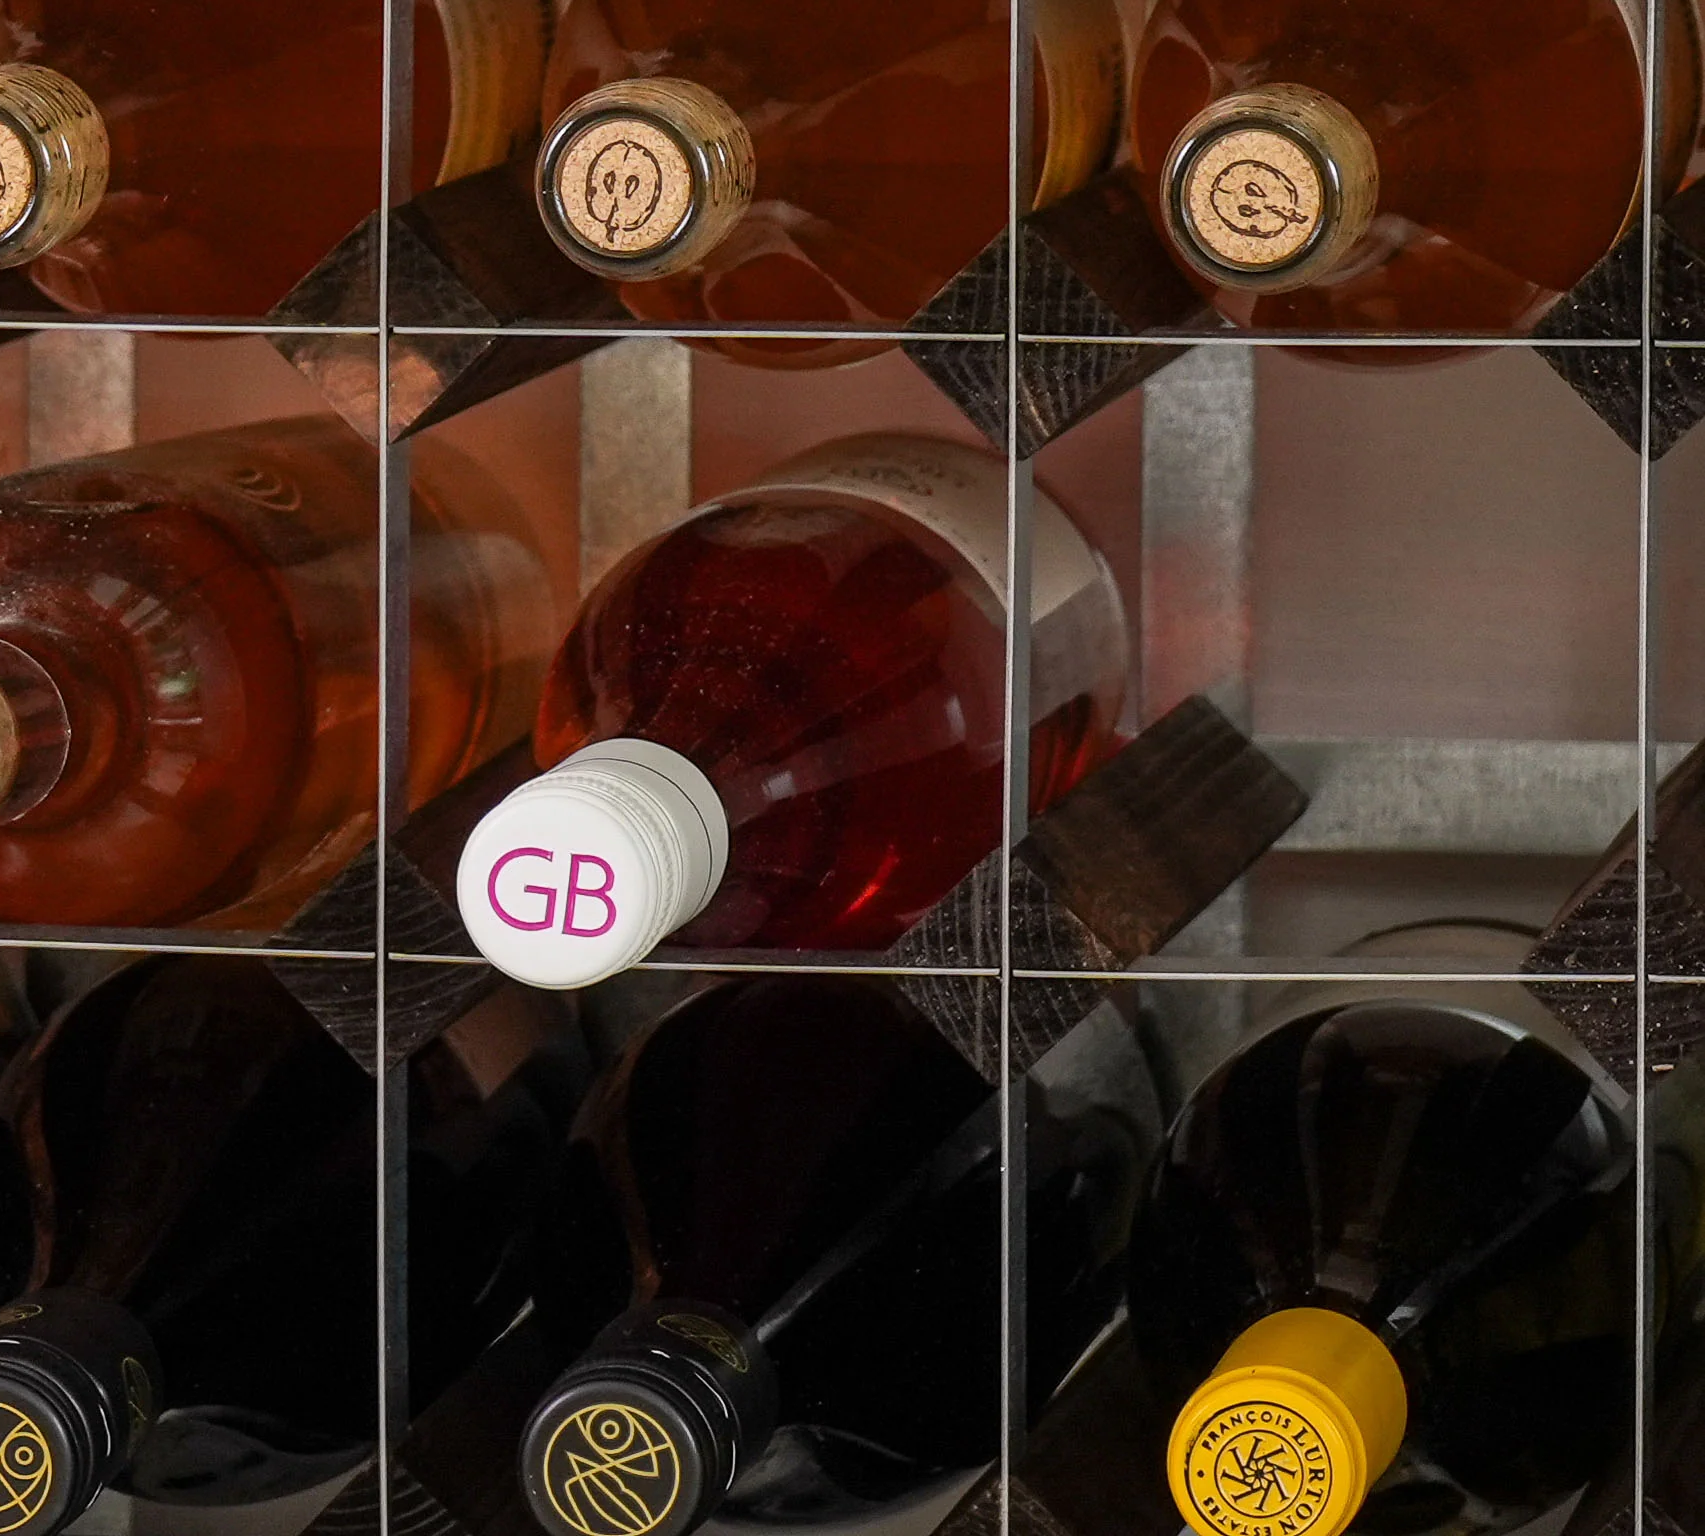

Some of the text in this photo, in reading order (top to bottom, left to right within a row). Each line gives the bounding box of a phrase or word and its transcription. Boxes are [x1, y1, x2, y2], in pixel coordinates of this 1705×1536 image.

[487, 846, 617, 938] GB
[1200, 1410, 1292, 1451] FRANÇOIS
[1278, 1426, 1327, 1535] LURTON
